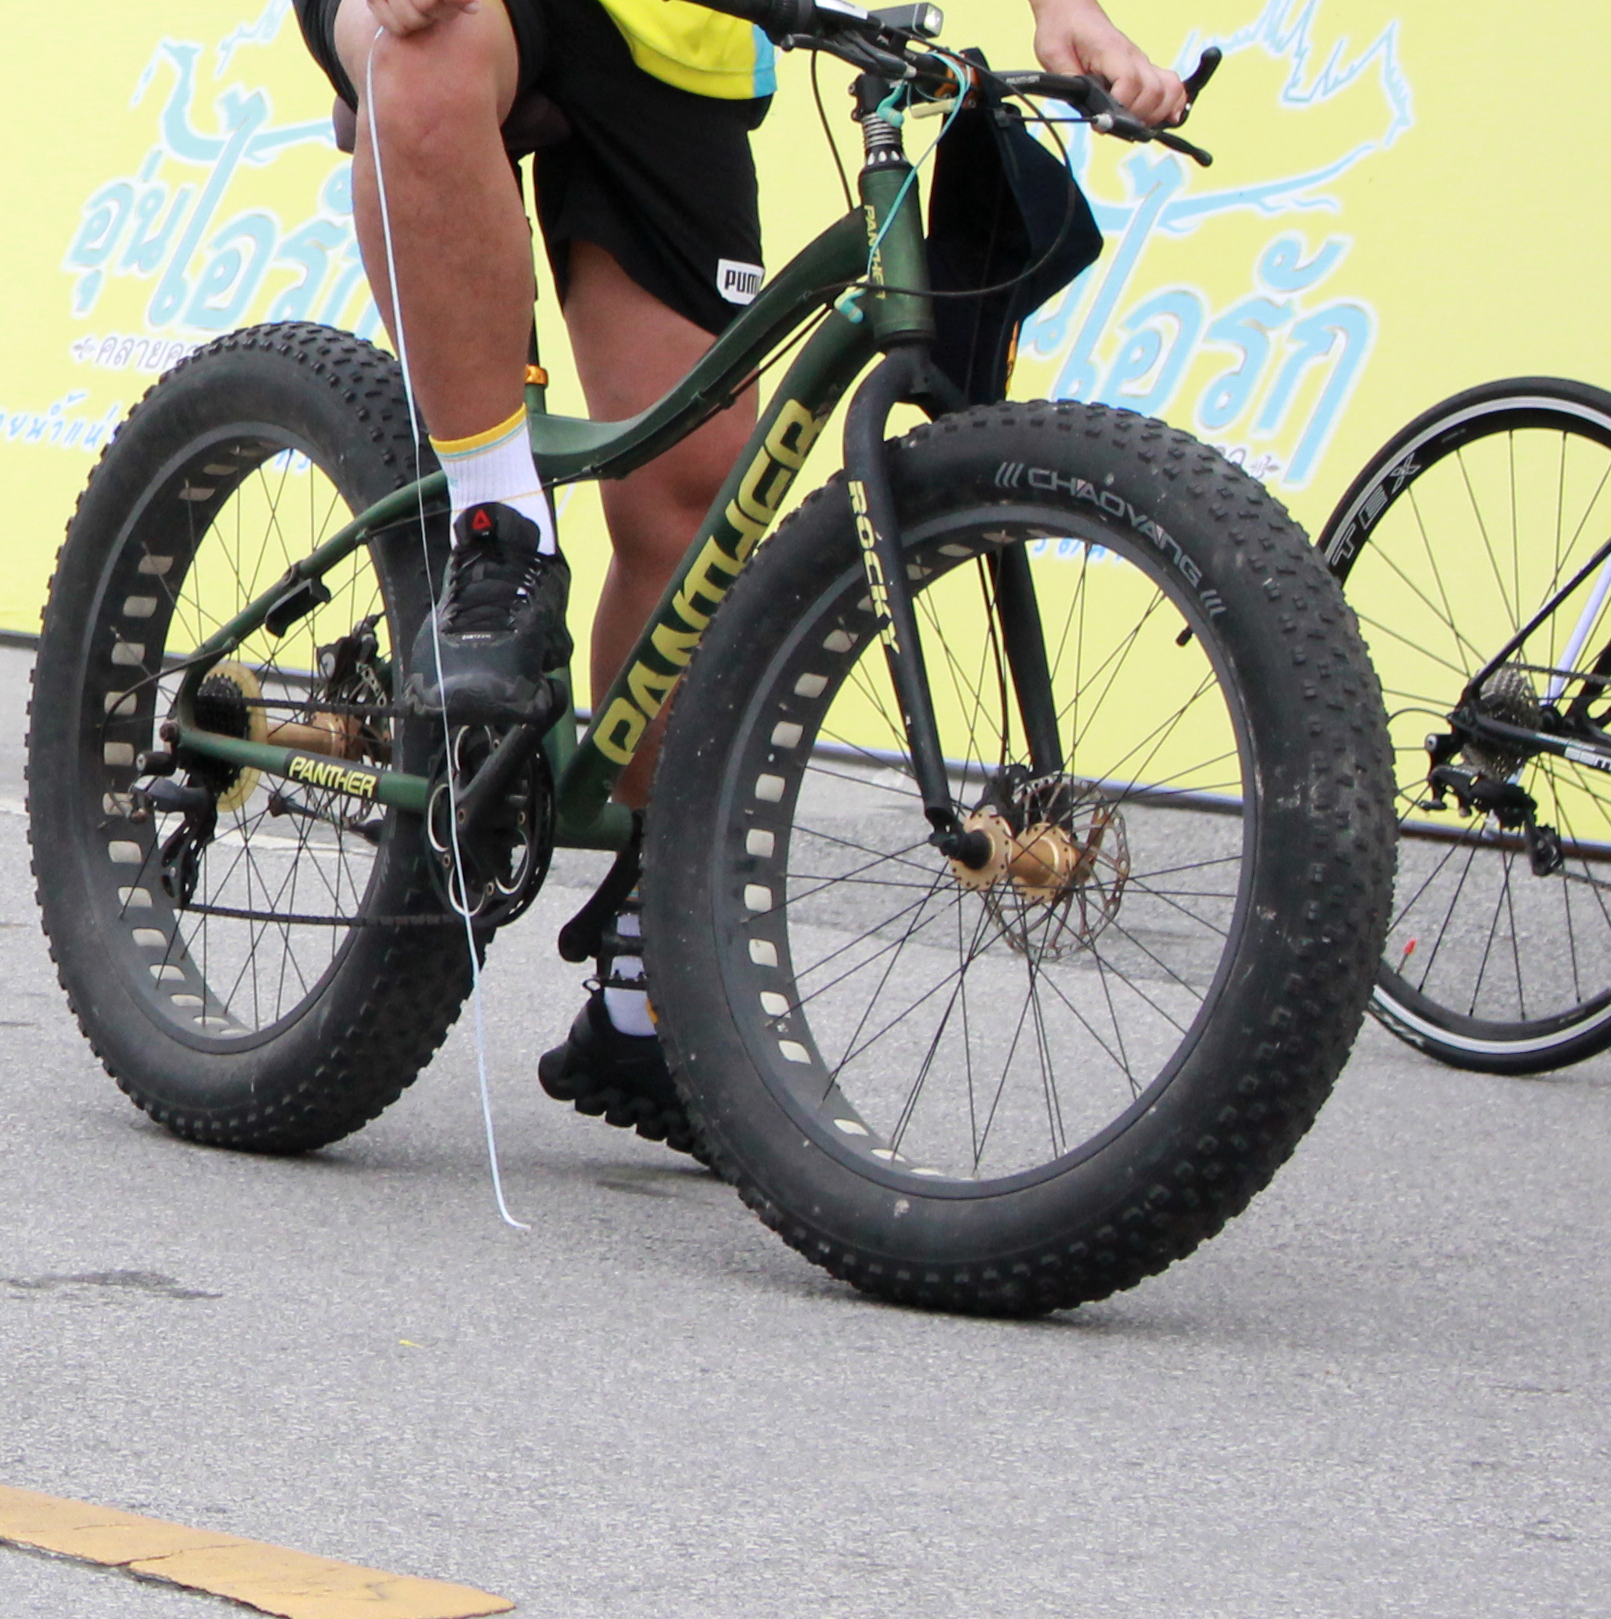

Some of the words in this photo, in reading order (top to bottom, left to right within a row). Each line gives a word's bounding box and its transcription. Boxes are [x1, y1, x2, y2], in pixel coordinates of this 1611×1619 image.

[724, 268, 760, 291] PUM
[593, 398, 825, 766] PANTHER
[847, 480, 902, 655] ROCKY
[288, 755, 377, 799] PANTHER
